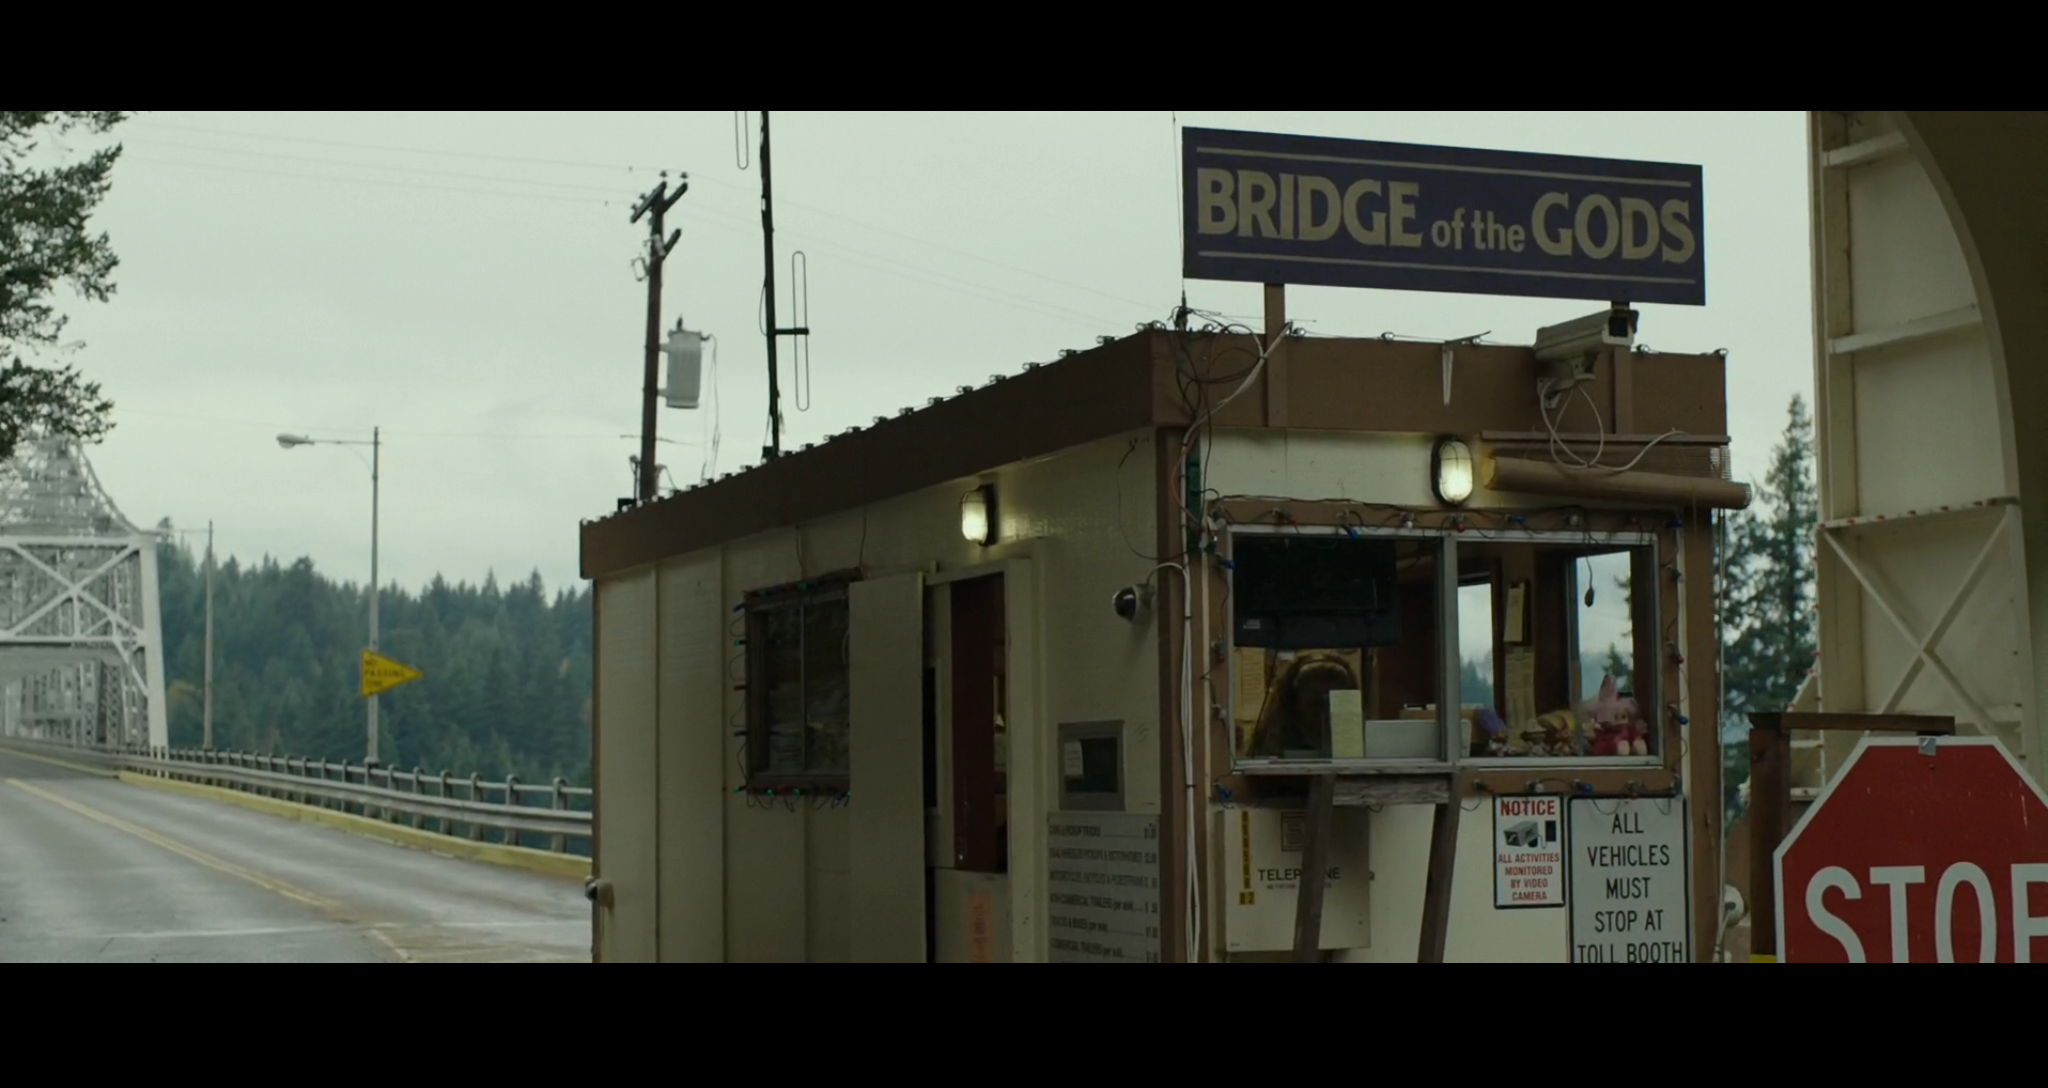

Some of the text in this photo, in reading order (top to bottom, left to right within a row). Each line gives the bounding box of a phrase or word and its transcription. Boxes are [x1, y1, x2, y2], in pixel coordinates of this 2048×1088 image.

[1196, 167, 1697, 265] BRIDGE of the GODS
[1500, 799, 1556, 817] NOTICE
[1611, 811, 1644, 835] ALL
[1498, 852, 1560, 864] ALL ACTIVITIES
[1586, 844, 1670, 867] VEHICLES
[1257, 867, 1341, 882] TELEPNE
[1504, 865, 1553, 876] MONITORED
[1510, 878, 1548, 888] BY VIDEO
[1605, 877, 1652, 900] MUST
[1511, 891, 1548, 901] CAMERA
[1594, 909, 1664, 933] STOP AT
[1577, 941, 1683, 963] TOLL BOOTH
